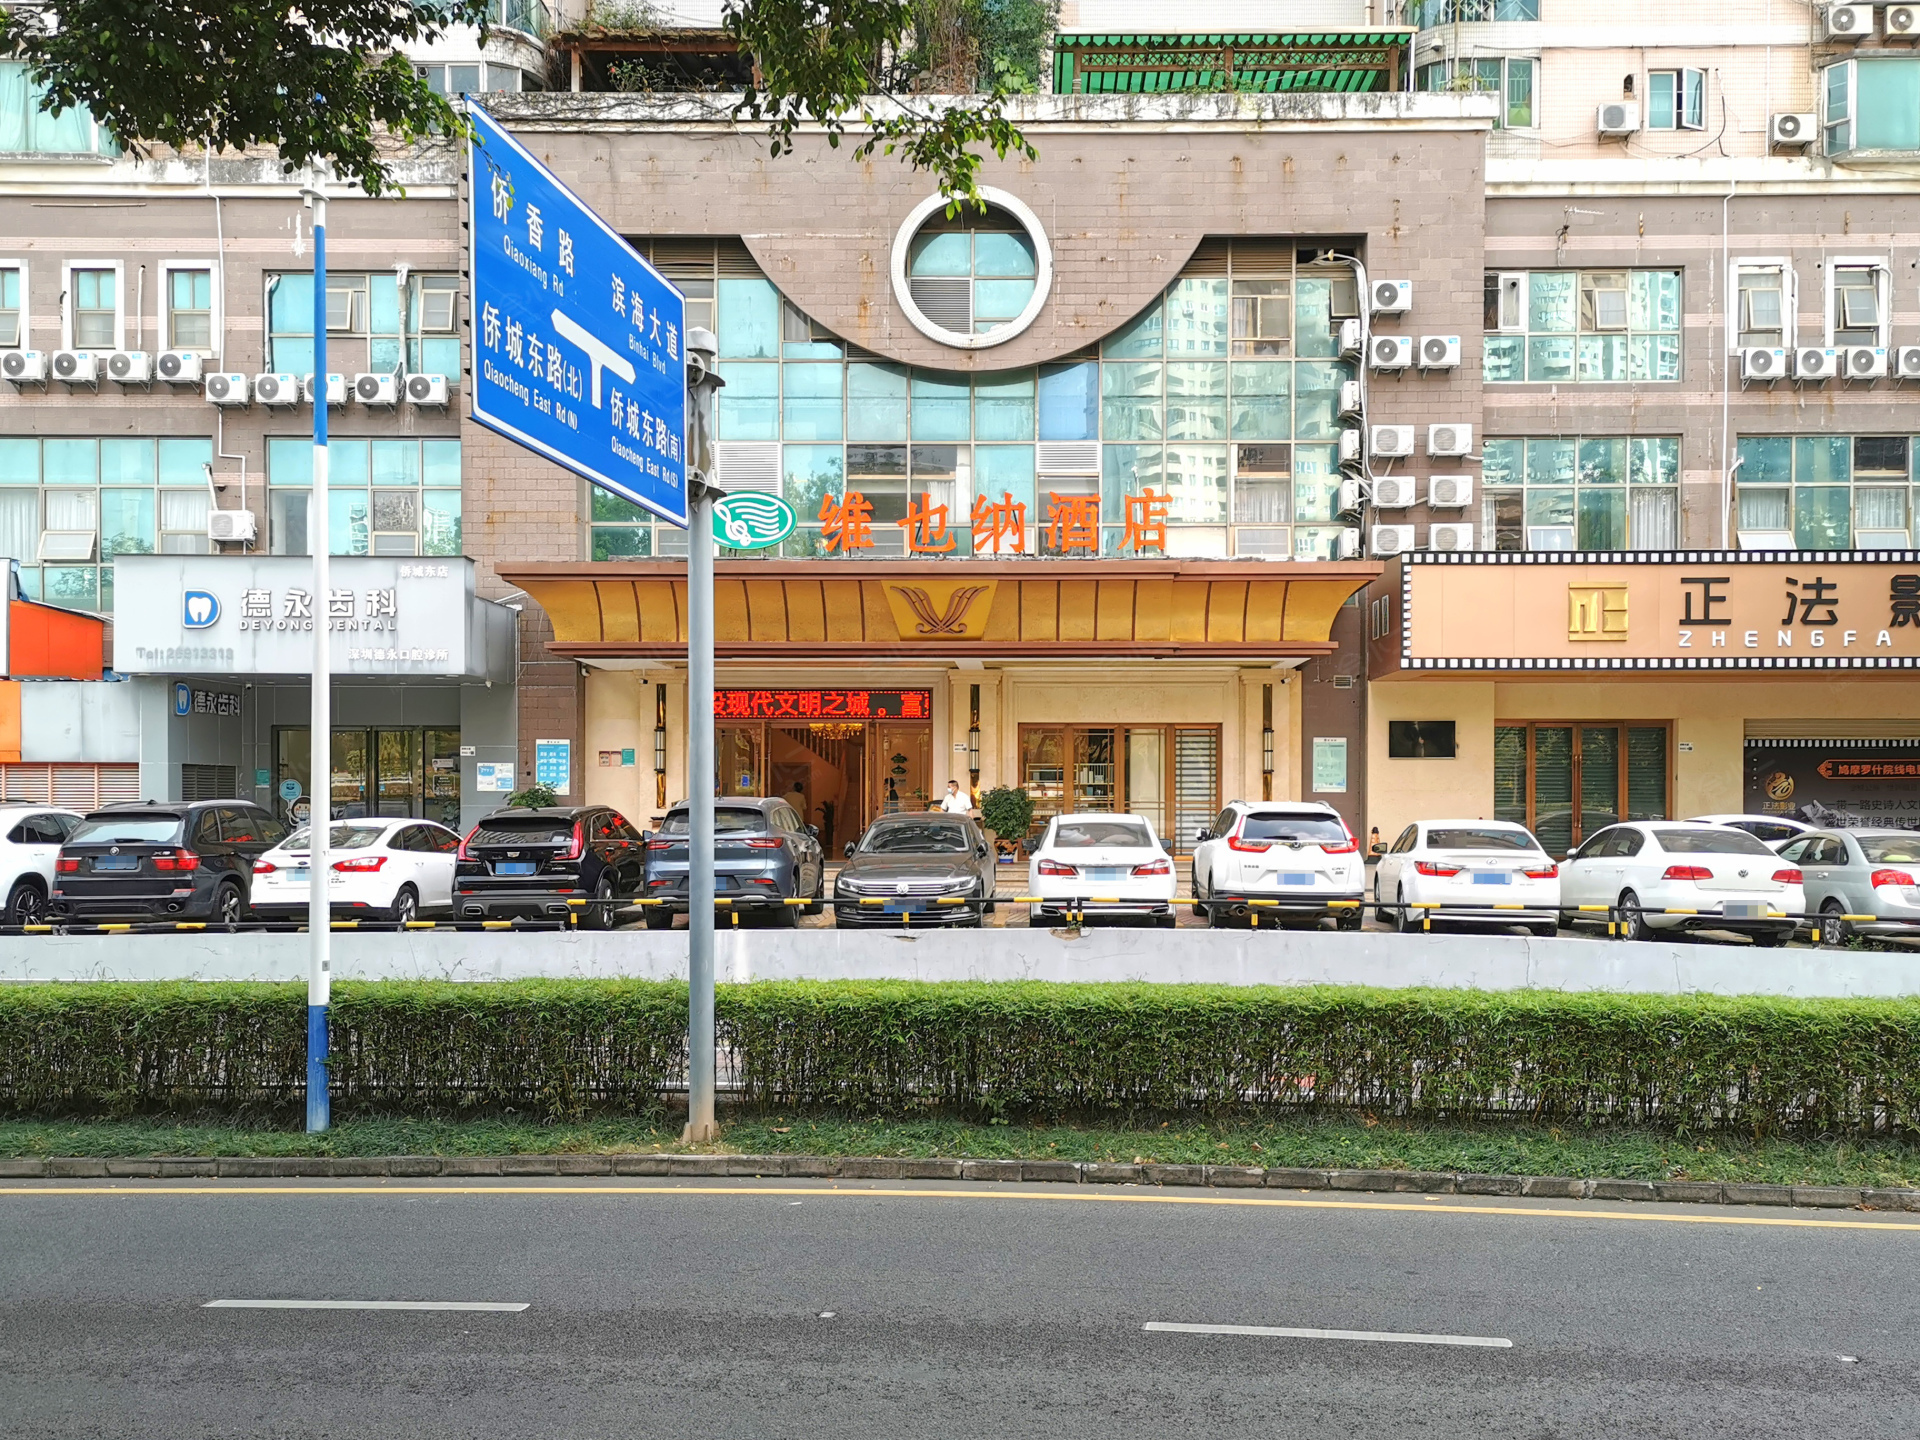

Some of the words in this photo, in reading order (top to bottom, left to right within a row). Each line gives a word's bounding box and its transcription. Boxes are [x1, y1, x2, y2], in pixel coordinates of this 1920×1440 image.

[491, 171, 575, 278] 侨香路
[503, 234, 548, 290] Qiaoxiang
[552, 273, 564, 298] Rd
[611, 271, 679, 362] 滨海大道
[482, 300, 583, 402] 侨城东路(北)
[628, 333, 649, 361] Binhai
[652, 351, 666, 375] Blvd
[484, 359, 529, 407] Qiaocheng
[533, 388, 551, 416] East
[610, 386, 682, 465] 侨城东路(南)
[611, 435, 644, 473] Qiaocheng
[646, 457, 660, 479] East
[816, 487, 1174, 554] 维也纳酒店
[400, 565, 449, 578] 侨城东店
[241, 588, 397, 618] 德永齿科
[240, 620, 313, 631] DEYONG
[1679, 630, 1892, 647] ZHENGFA
[348, 649, 449, 661] 深圳德永口腔诊所
[194, 691, 241, 717] 德永齿科
[714, 692, 929, 716] 现代文明之城。富
[1825, 799, 1920, 811] 一带一路史诗人文
[1825, 816, 1920, 828] 盛世荣誉经典传世
